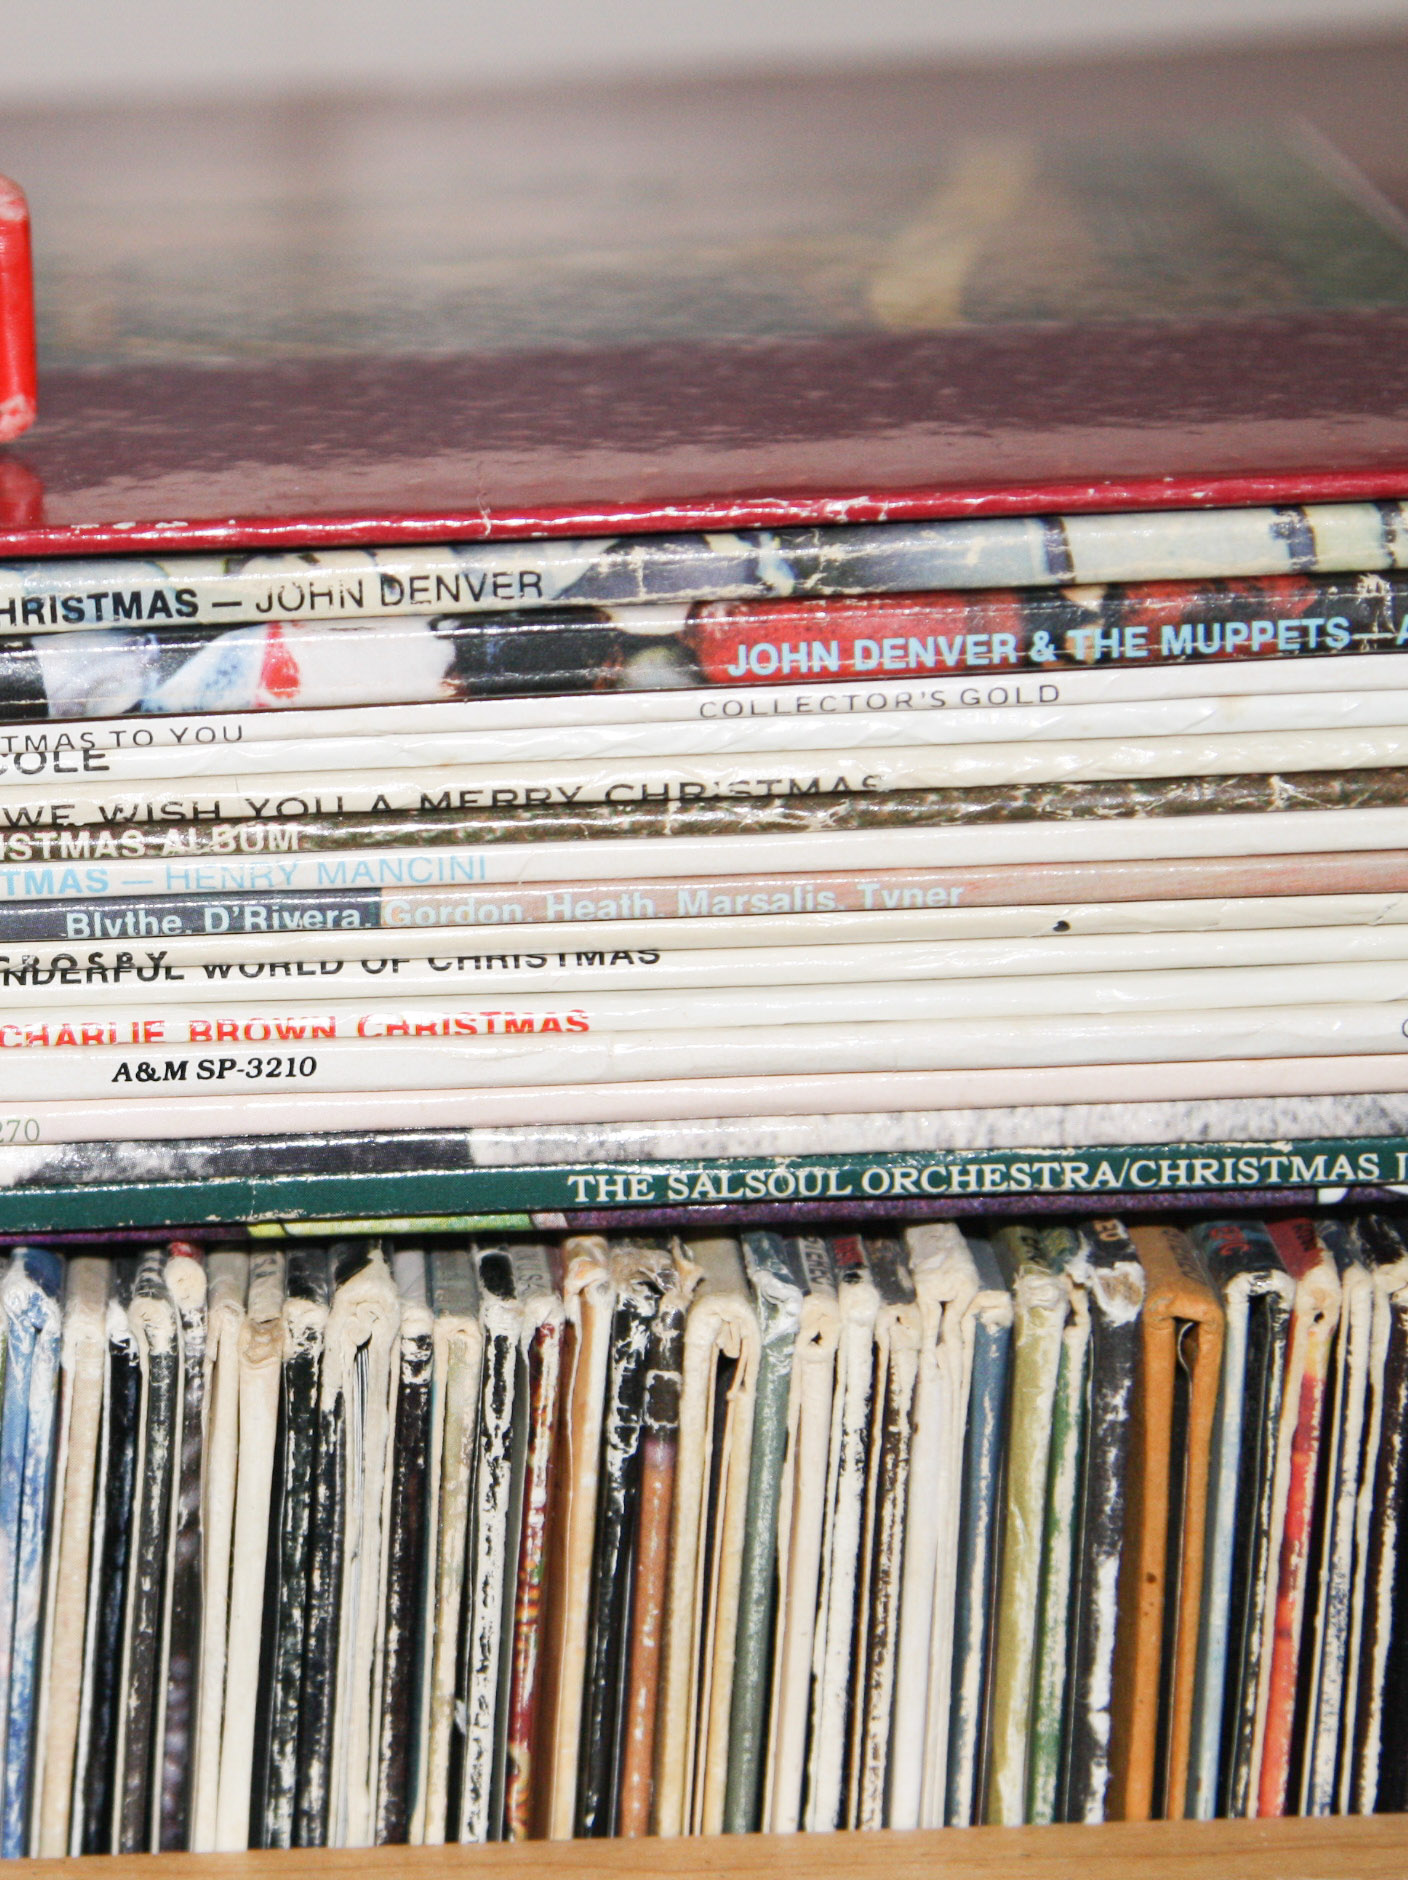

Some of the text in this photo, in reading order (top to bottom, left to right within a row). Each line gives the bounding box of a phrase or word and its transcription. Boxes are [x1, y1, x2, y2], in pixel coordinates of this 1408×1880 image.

[256, 580, 364, 614] JOHN
[380, 571, 543, 606] DENVER
[728, 640, 839, 677] JOHN
[854, 633, 1017, 670] DENVER
[1029, 630, 1057, 662] &
[1066, 625, 1149, 660] THE
[1161, 616, 1351, 656] MUPPETS
[700, 684, 1060, 719] COLLECTOR'S GOLD
[109, 729, 154, 748] TO
[169, 725, 243, 744] YOU
[2, 803, 76, 828] WE
[98, 800, 221, 824] WISH
[245, 796, 344, 819] YOU
[370, 793, 393, 813] A
[420, 785, 583, 810] MERRY
[160, 822, 300, 856] ALBUM
[166, 859, 299, 890] HENRY
[318, 854, 487, 885] MANCINI
[203, 960, 344, 979] WORLD
[427, 949, 661, 972] CHRISTMAS
[189, 1014, 337, 1043] BROWN
[358, 1009, 591, 1040] CHRISTMAS
[112, 1060, 188, 1083] A&M
[196, 1056, 318, 1080] SP-3210
[568, 1172, 656, 1203] THE
[666, 1168, 853, 1200] SALSOUL
[861, 1151, 1381, 1196] ORCHESTRA/CHRISTMAS
